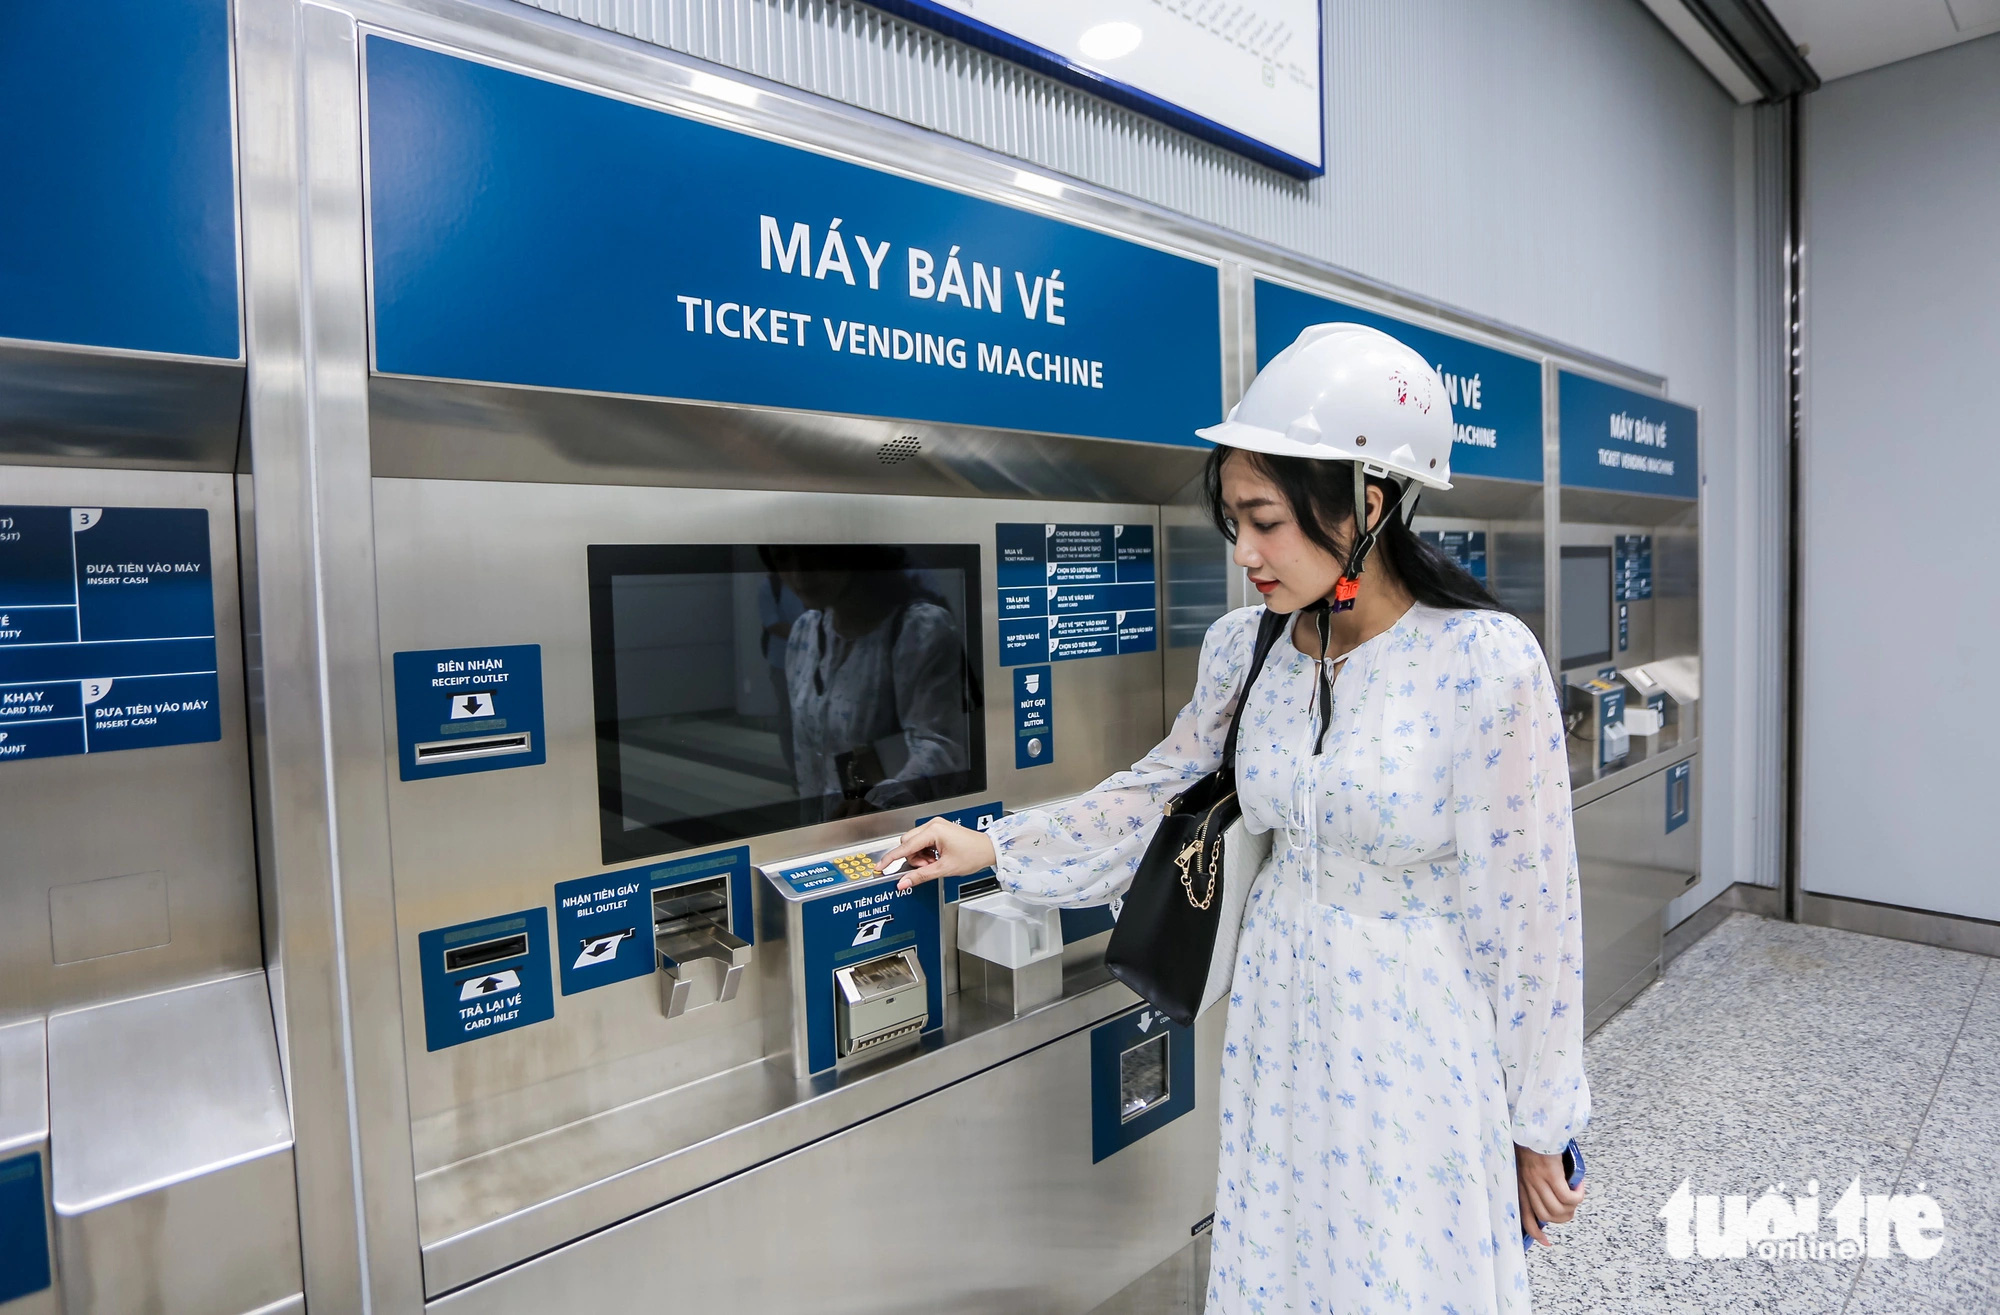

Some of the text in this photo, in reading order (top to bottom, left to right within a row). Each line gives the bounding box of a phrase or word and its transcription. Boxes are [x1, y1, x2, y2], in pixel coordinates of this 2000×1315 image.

[760, 214, 1066, 326] MÁY BÁN VÉ
[677, 295, 1103, 389] TICKET VENDING MACHINE
[1461, 373, 1482, 410] VÉ
[1610, 411, 1667, 448] MÁY BÁN VÉ
[80, 513, 90, 525] 3
[86, 564, 114, 574] ĐƯA
[147, 562, 172, 572] VÀO
[175, 561, 200, 572] MÁY
[87, 576, 149, 585] INSERT CASH
[437, 658, 503, 673] BIÊN NHẬN
[432, 673, 509, 687] RECEIPT OUTLET
[4, 691, 44, 704] KHAY
[91, 685, 100, 696] 3
[0, 704, 54, 716] CARD TRAY
[95, 707, 123, 718] ĐƯA
[155, 702, 180, 713] VÀO
[182, 699, 209, 711] MÁY
[1021, 699, 1046, 708] NÚT GỌI
[96, 717, 157, 729] INSERT CASH
[1024, 719, 1043, 727] BUTTON
[790, 866, 829, 880] BÀN PHÍM
[804, 877, 834, 888] KEYPAD
[562, 893, 591, 908] NHẬN
[577, 900, 628, 918] BILL OUTLET
[833, 902, 852, 914] ĐƯA
[858, 904, 890, 919] BILL INLET
[459, 992, 522, 1019] TRẢ LẠI VÉ
[465, 1010, 519, 1031] CARD INLET
